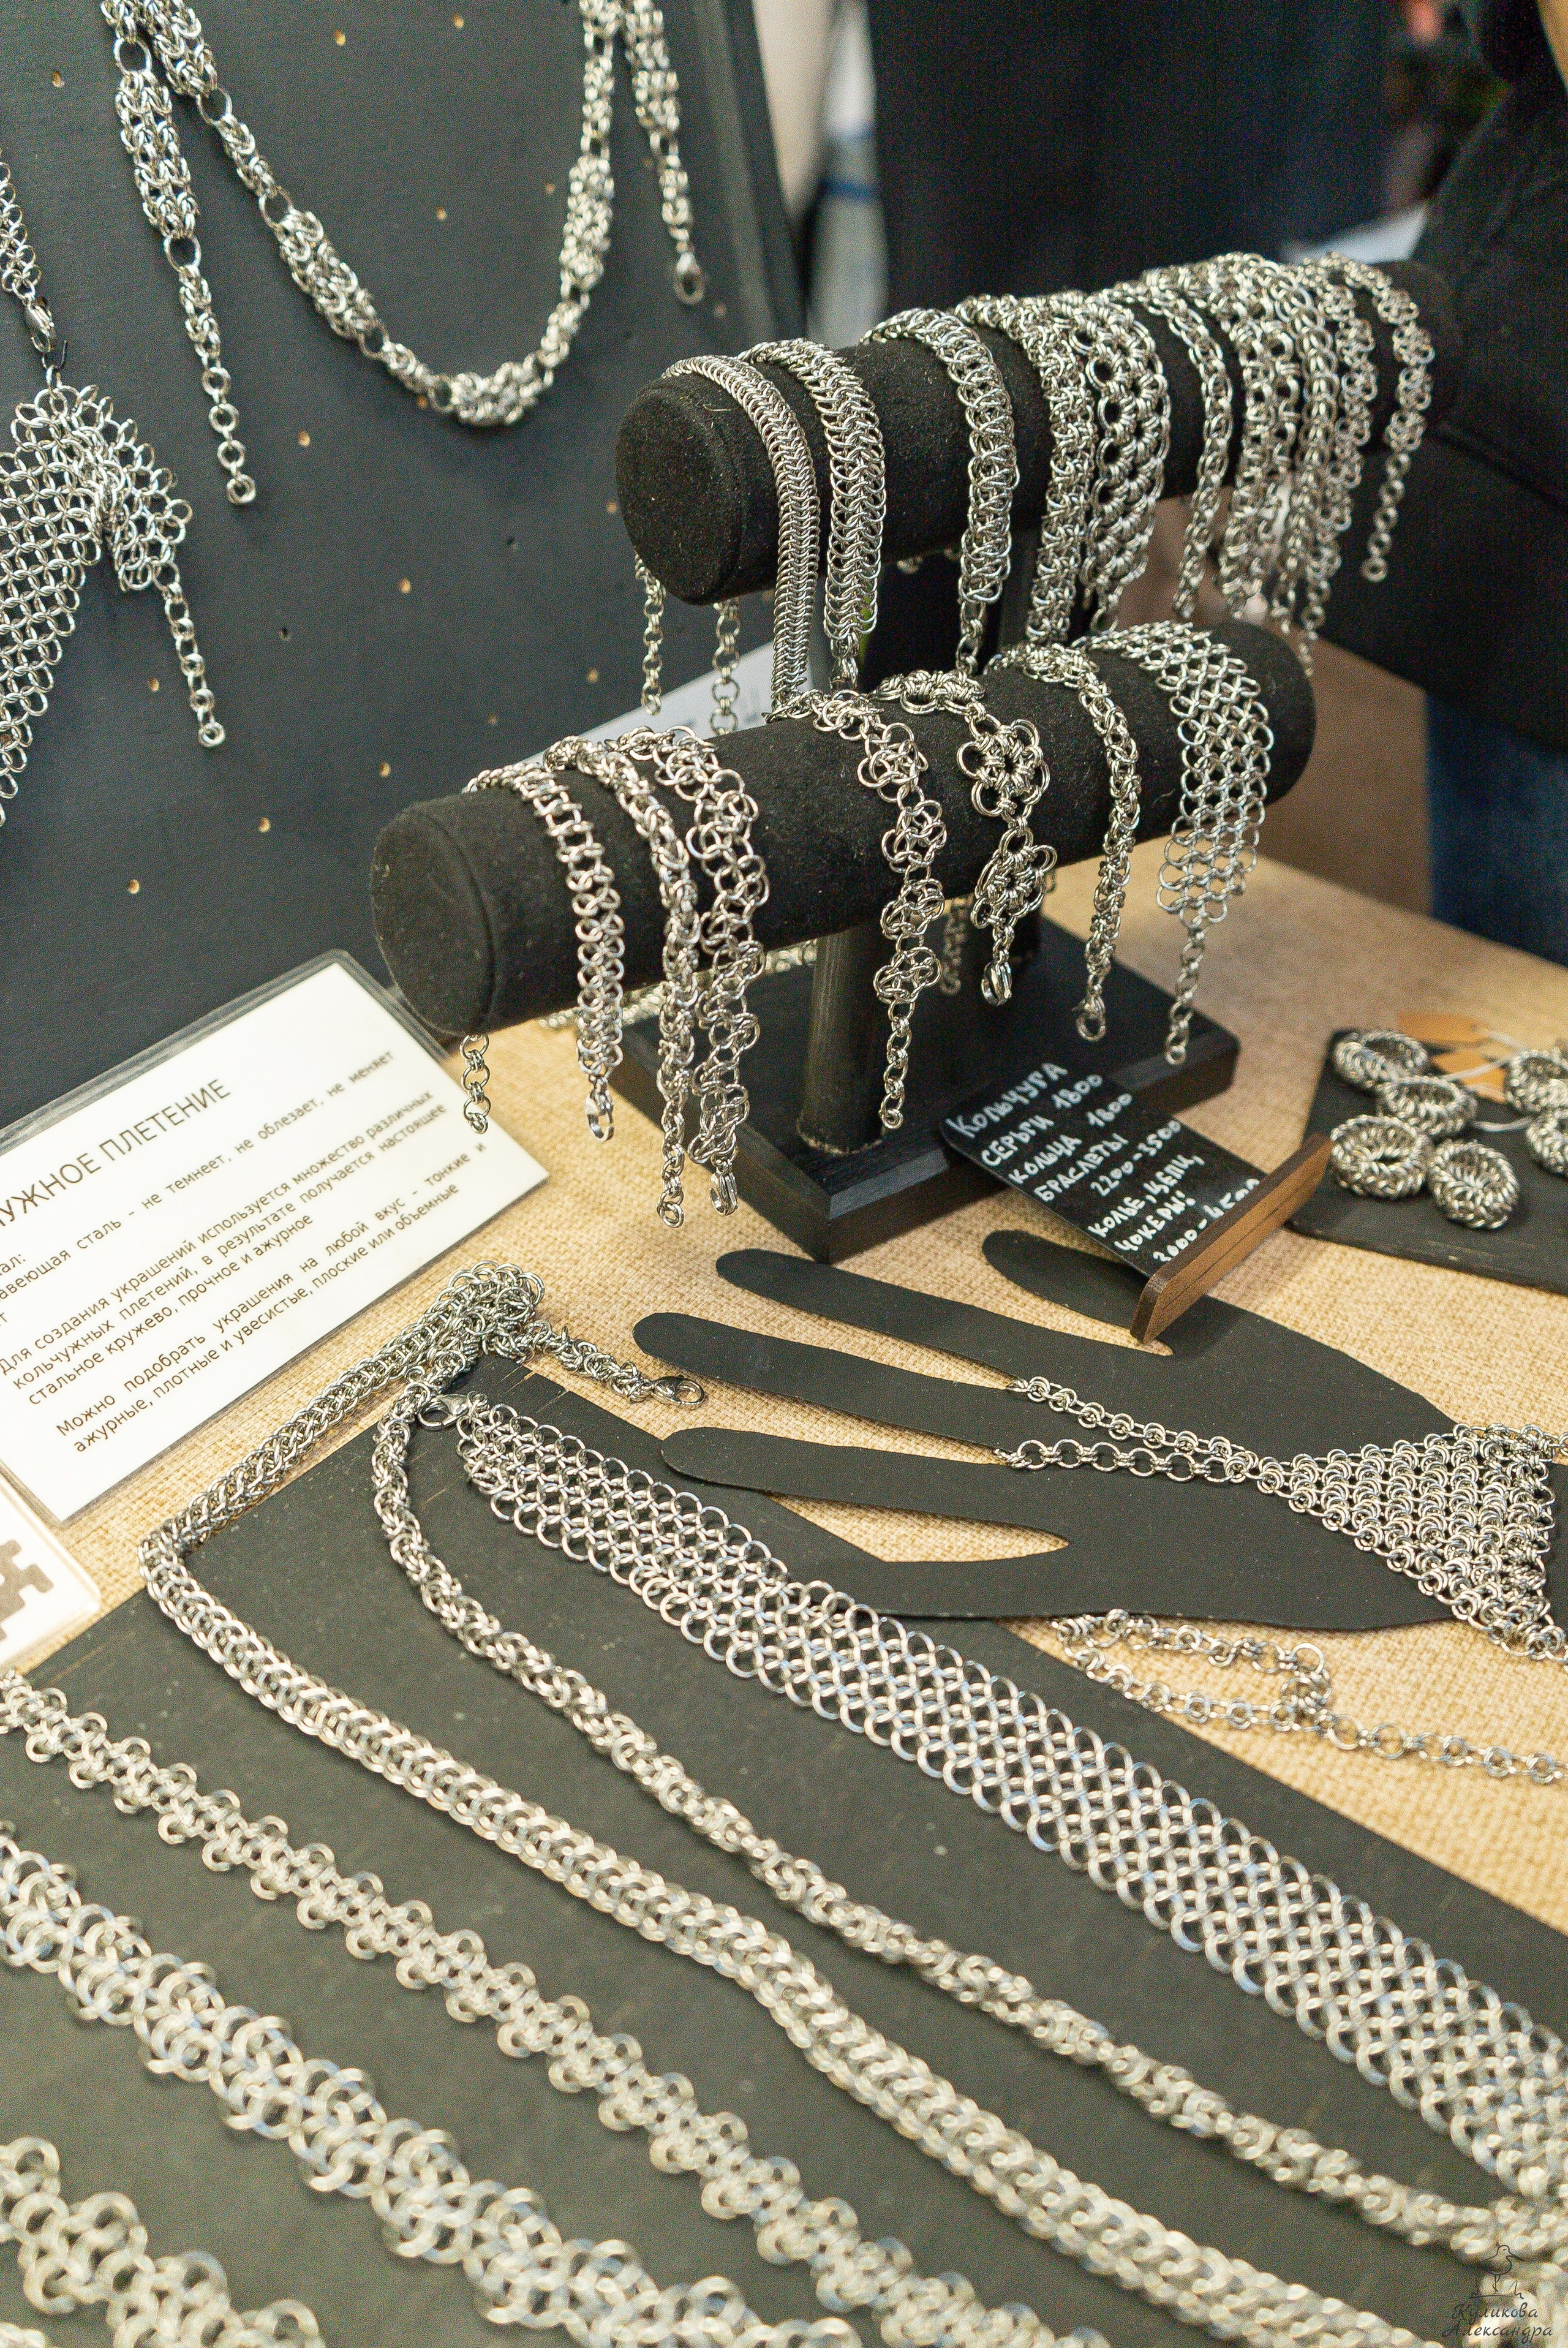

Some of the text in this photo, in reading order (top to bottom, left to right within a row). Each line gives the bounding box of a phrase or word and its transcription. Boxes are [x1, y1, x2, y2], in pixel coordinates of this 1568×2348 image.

[77, 1221, 121, 1249] сталь
[141, 1194, 162, 1209] не
[165, 1155, 231, 1193] темнеет,
[235, 1139, 254, 1153] не
[258, 1099, 323, 1139] облезает,
[327, 1083, 345, 1097] не
[349, 1051, 393, 1083] меняет
[99, 1079, 231, 1161] ПЛЕТЕНИЕ
[981, 1074, 1102, 1166] СЕРЬГИ 1800
[1008, 1134, 1082, 1184] КОЛЬЦА
[1033, 1133, 1129, 1202] БРАСЛЕТЫ
[0, 1091, 432, 1376] Для создания украшений используется множество различных
[0, 1254, 26, 1276] ал:
[13, 1104, 447, 1389] кольчужных плетений, в результате получается настоящее
[29, 1215, 313, 1405] стальное кружево, прочное и ажурное
[56, 1395, 115, 1436] Можно
[124, 1336, 206, 1392] подобрать
[213, 1274, 293, 1334] украшения
[299, 1258, 318, 1272] на
[325, 1221, 369, 1256] любой
[374, 1198, 405, 1221] вкус
[424, 1153, 470, 1185] тонкие
[476, 1143, 486, 1152] и
[74, 1185, 459, 1452] ажурные, плотные и увесистые, плоские или объемные
